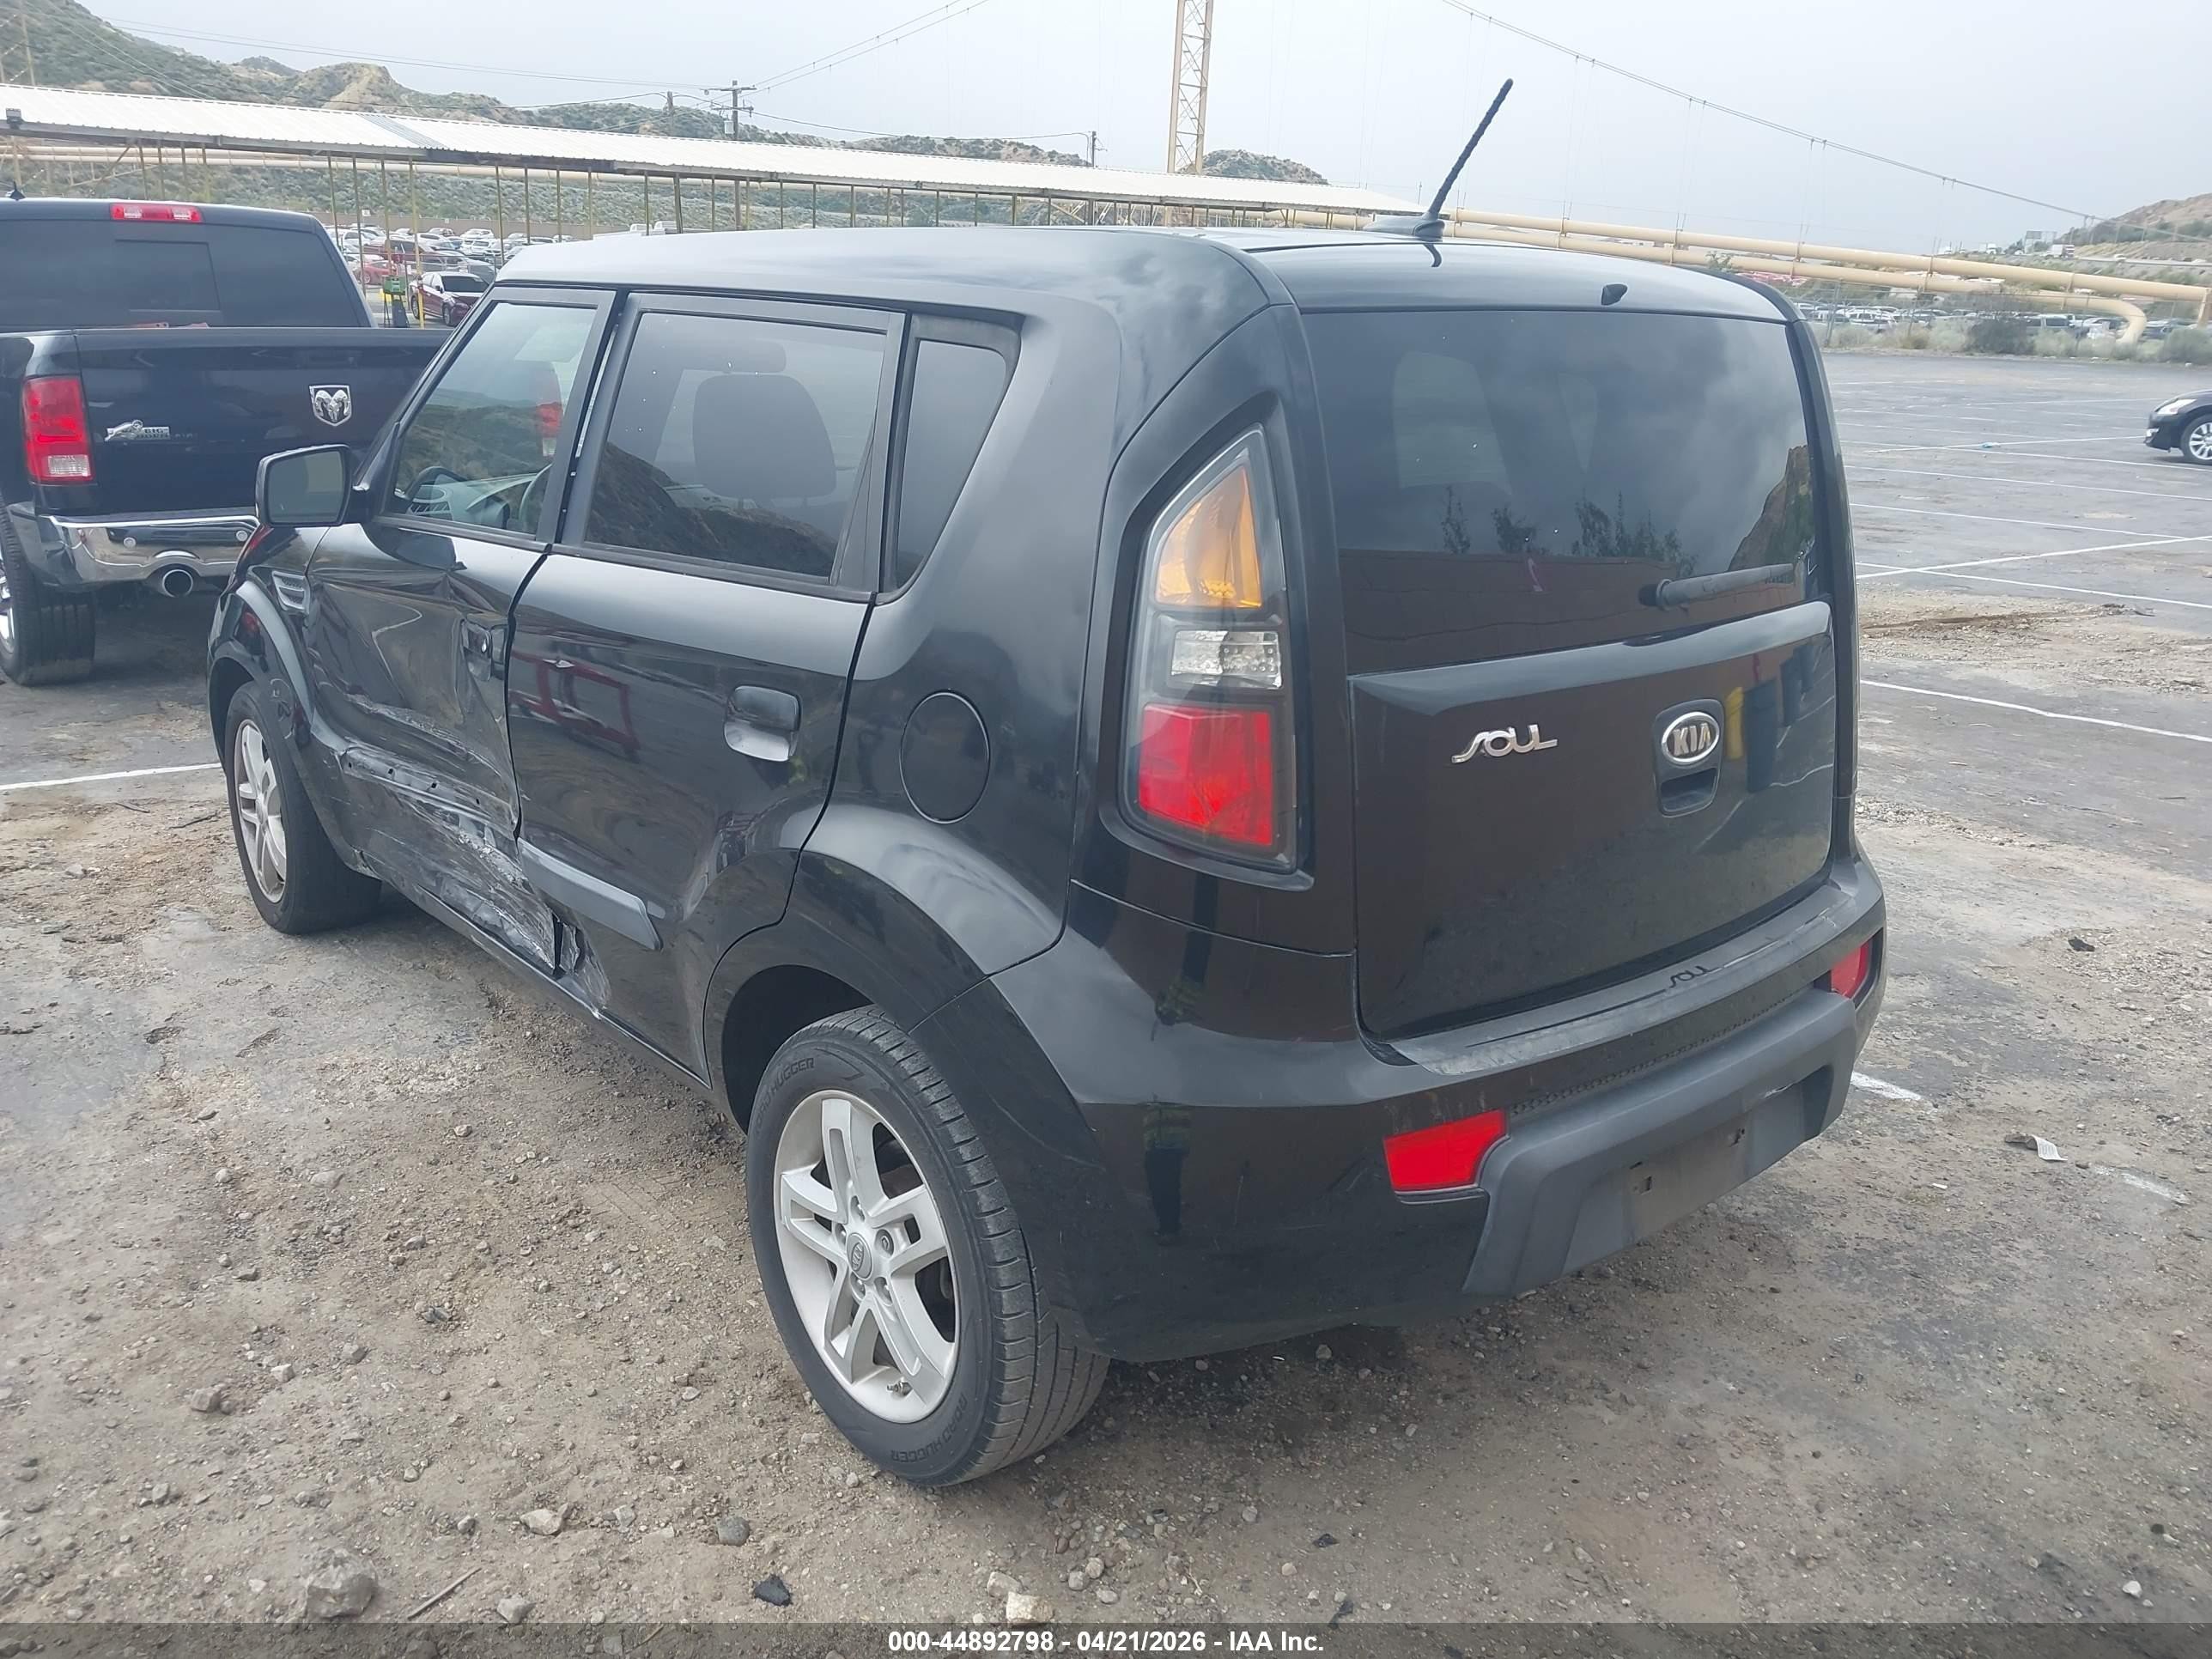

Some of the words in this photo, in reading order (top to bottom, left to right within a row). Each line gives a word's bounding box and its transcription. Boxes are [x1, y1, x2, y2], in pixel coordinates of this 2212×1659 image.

[1451, 724, 1559, 763] SOUL
[1673, 722, 1711, 756] KIA
[769, 1057, 815, 1096] HUGGER
